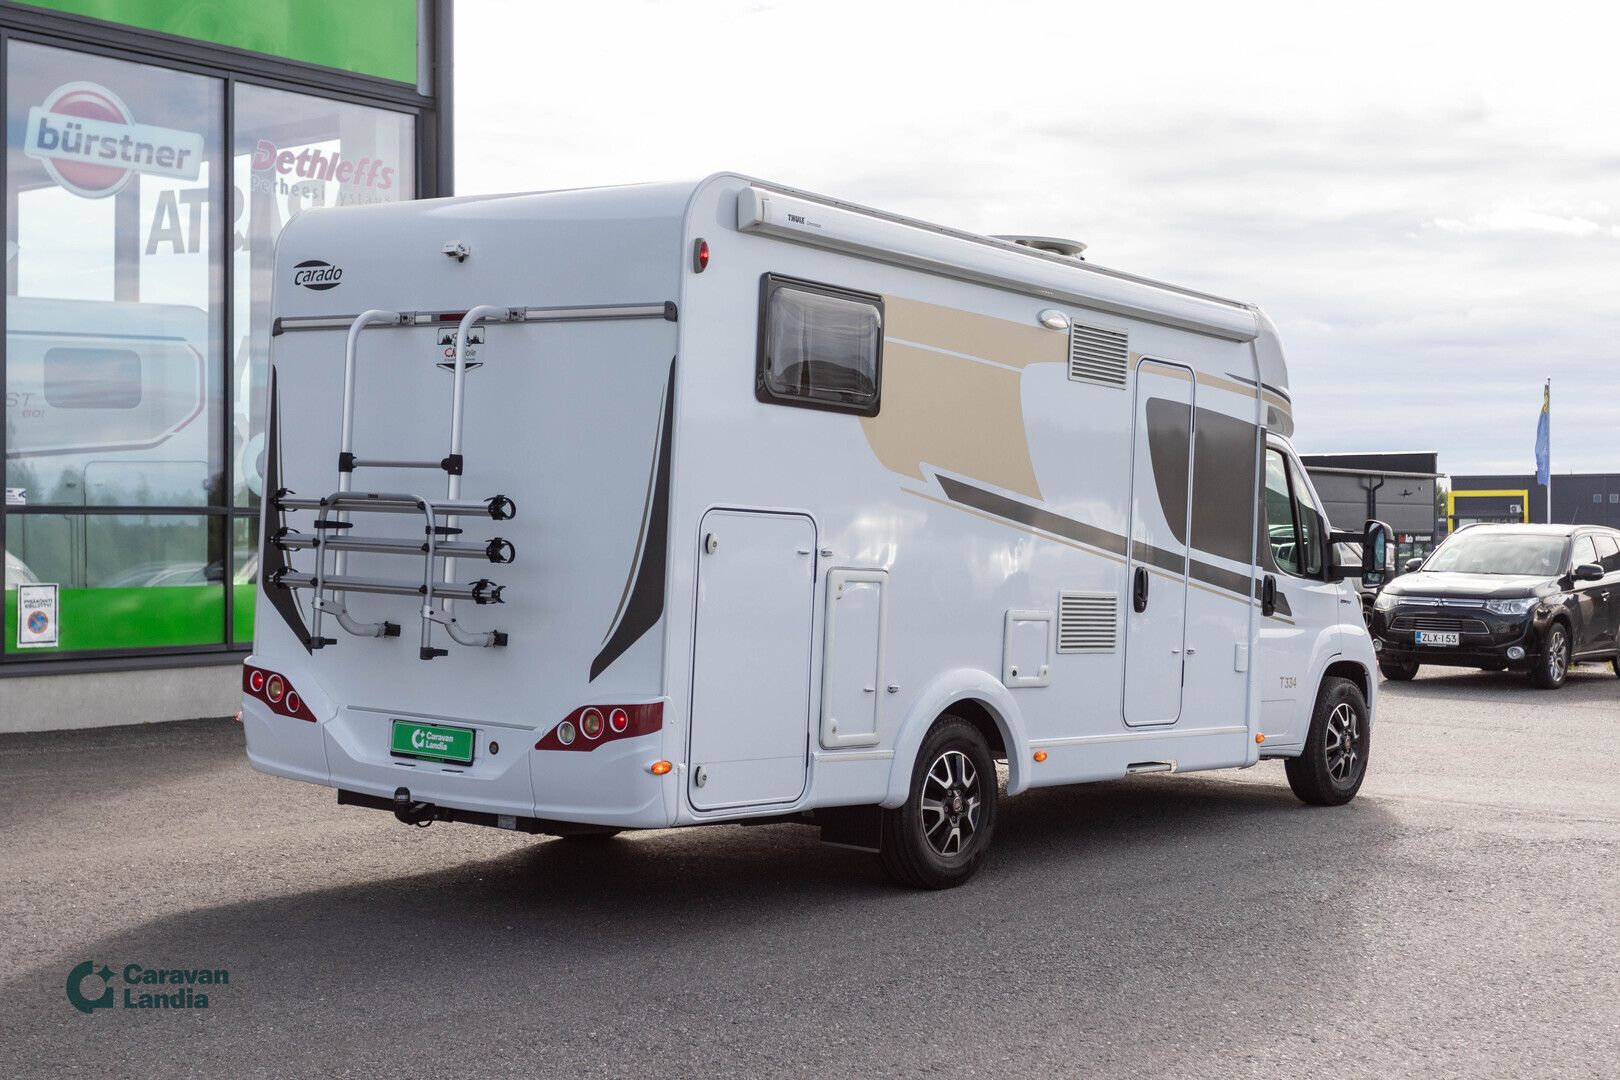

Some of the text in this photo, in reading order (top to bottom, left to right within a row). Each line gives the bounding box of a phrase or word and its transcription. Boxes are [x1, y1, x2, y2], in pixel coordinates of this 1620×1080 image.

[37, 117, 191, 169] bürstner
[251, 140, 394, 190] Dethleffs
[1422, 633, 1457, 643] ZLX-153
[426, 731, 454, 743] Caravan
[425, 740, 448, 751] Landia
